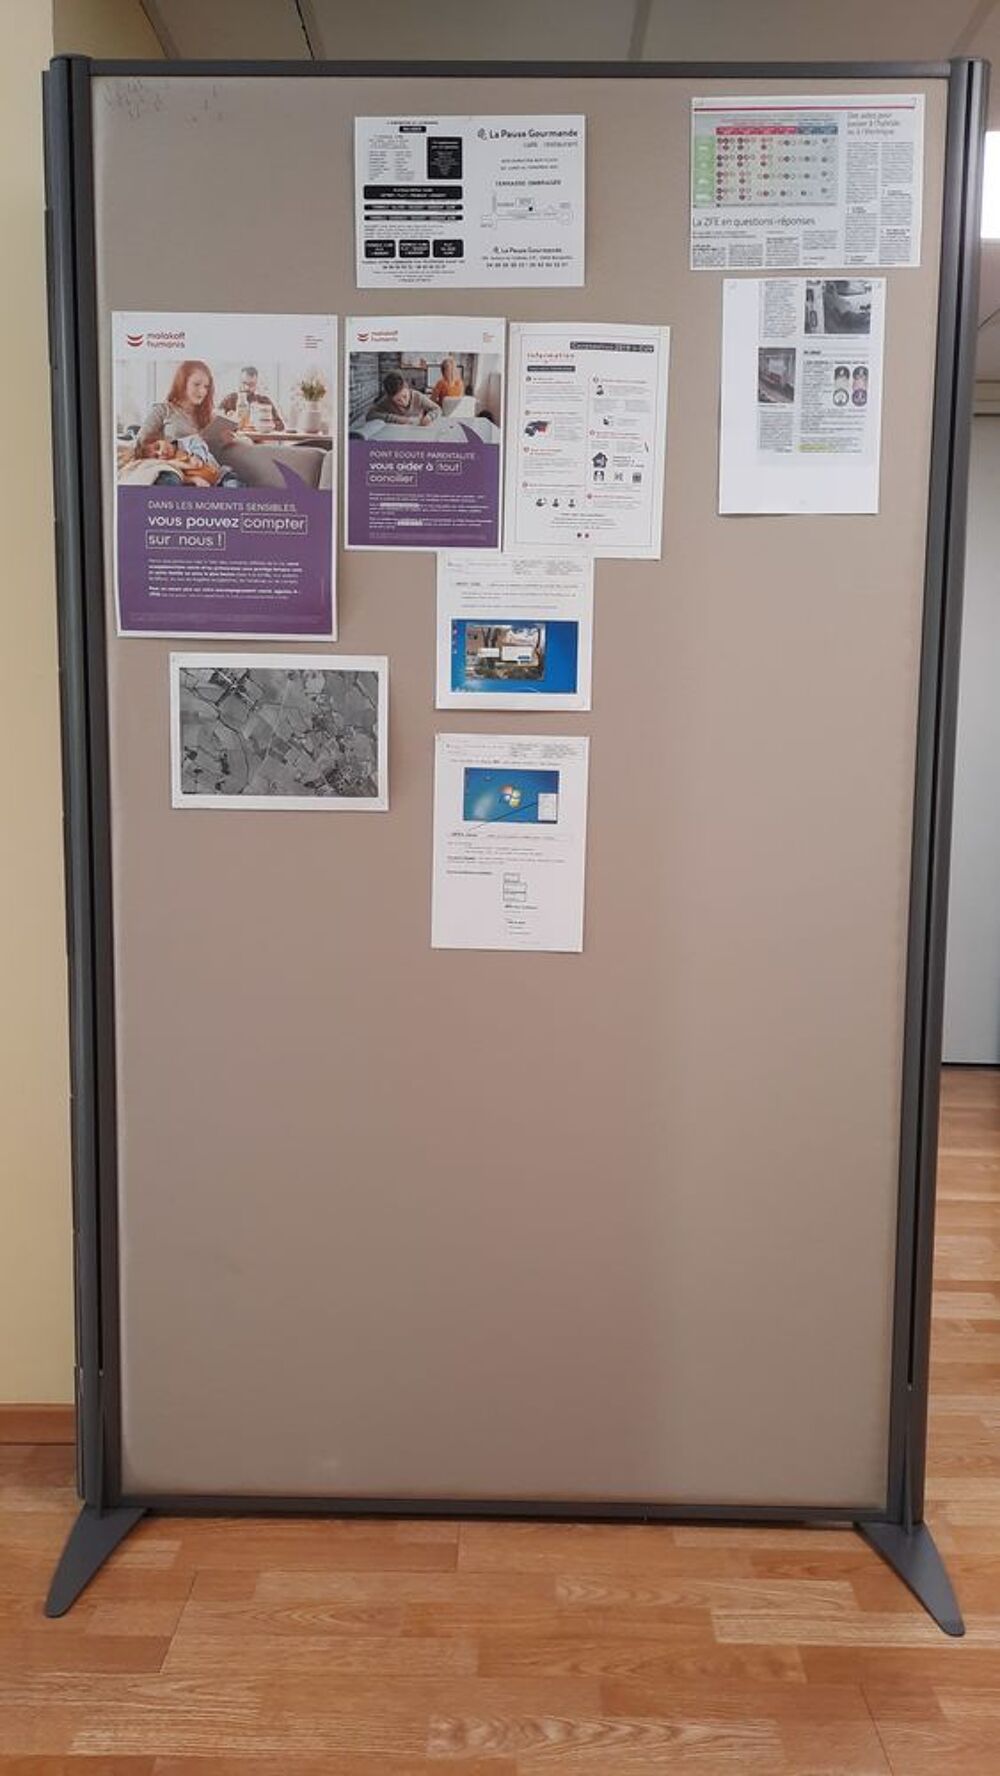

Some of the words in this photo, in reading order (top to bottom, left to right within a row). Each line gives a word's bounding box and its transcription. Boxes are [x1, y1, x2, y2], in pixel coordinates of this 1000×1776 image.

[489, 129, 499, 139] La
[500, 128, 526, 138] Pause
[528, 128, 578, 138] Gourmande
[692, 216, 702, 226] La
[703, 216, 720, 226] ZFE
[721, 218, 732, 226] en
[147, 331, 186, 340] malakoff
[147, 340, 186, 349] humanis
[369, 450, 392, 458] POINT
[369, 462, 394, 470] vous
[396, 461, 423, 470] aider
[425, 461, 434, 471] à
[438, 462, 459, 471] tout
[369, 475, 414, 483] concilier
[148, 500, 174, 510] DANS
[176, 501, 193, 510] LES
[194, 501, 244, 511] MOMENTS
[148, 516, 182, 527] vous
[186, 516, 239, 529] pouvez
[243, 517, 305, 532] compter
[148, 534, 171, 545] sur
[178, 534, 214, 546] nous
[217, 533, 222, 546] !
